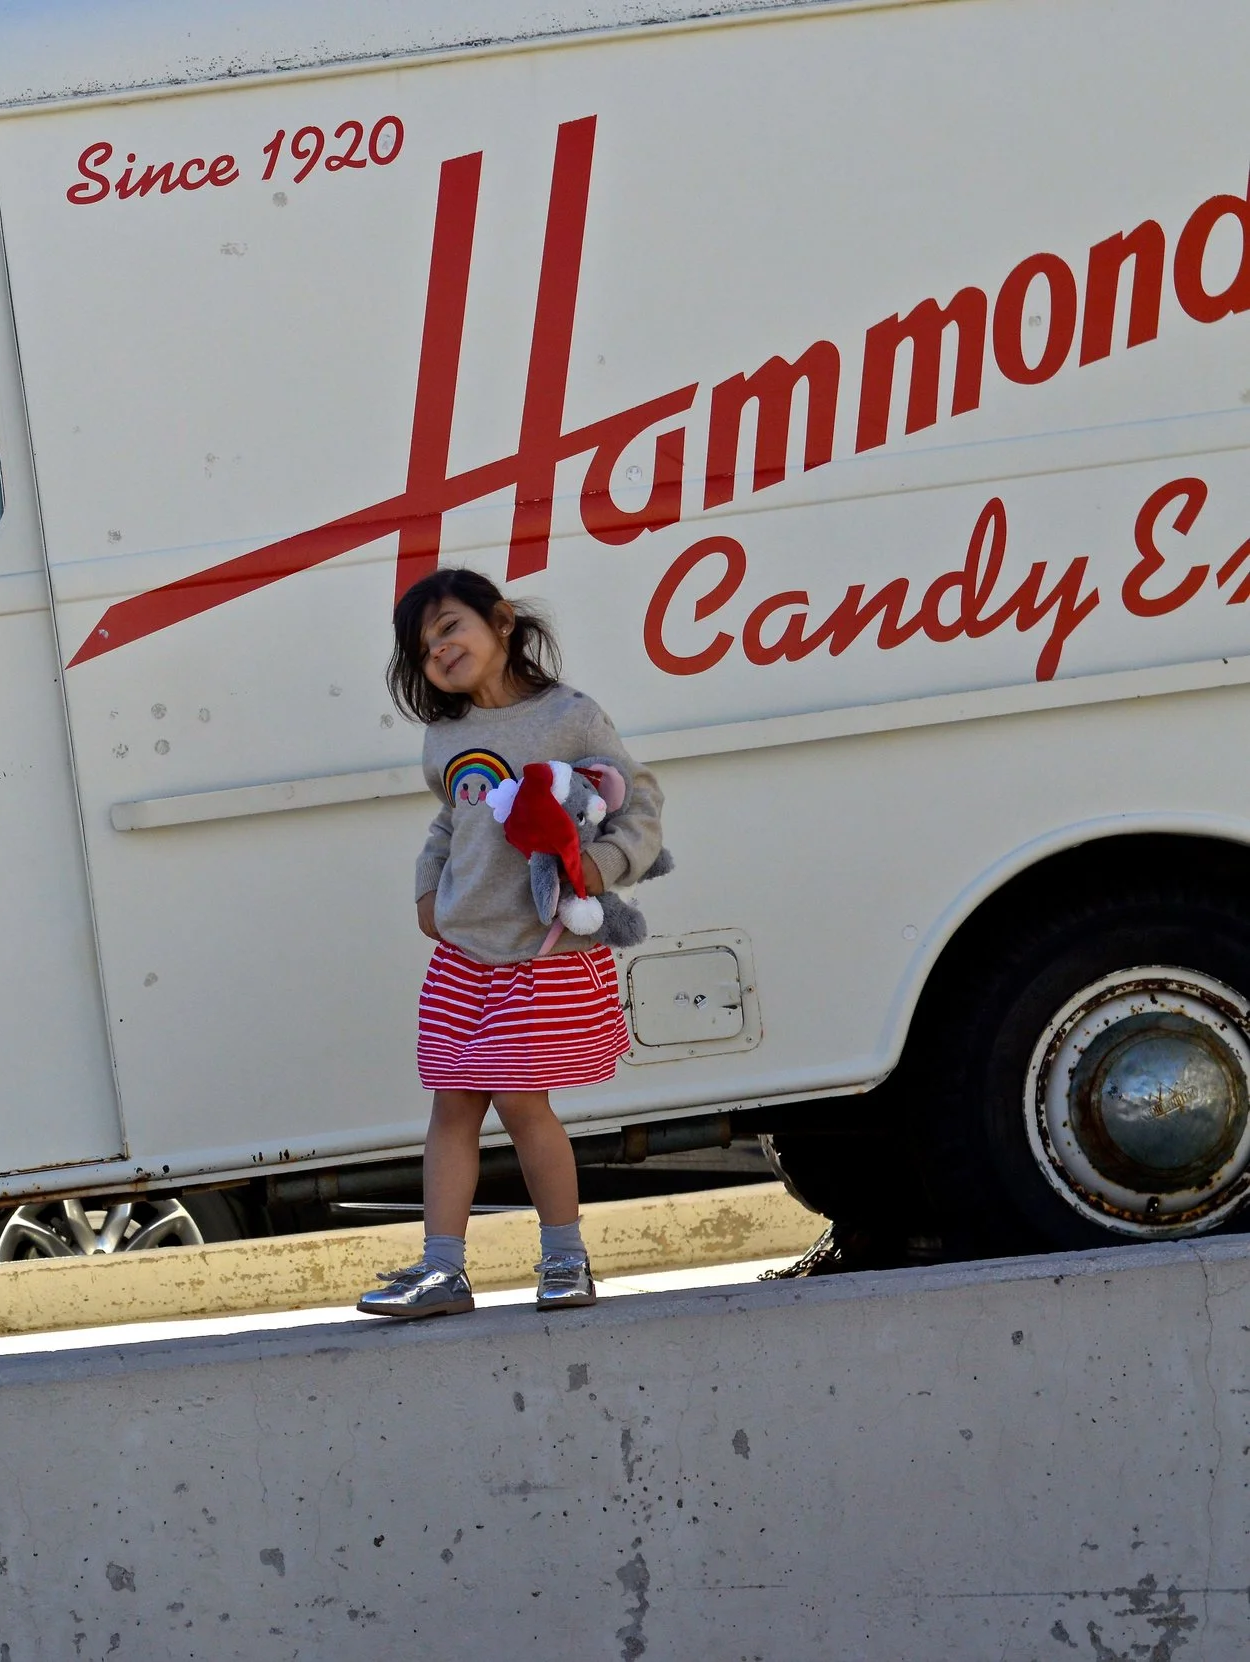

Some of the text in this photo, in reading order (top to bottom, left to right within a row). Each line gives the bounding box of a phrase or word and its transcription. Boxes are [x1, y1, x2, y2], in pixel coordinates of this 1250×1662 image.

[67, 115, 404, 205] Since 1920
[643, 497, 1100, 682] Candy
